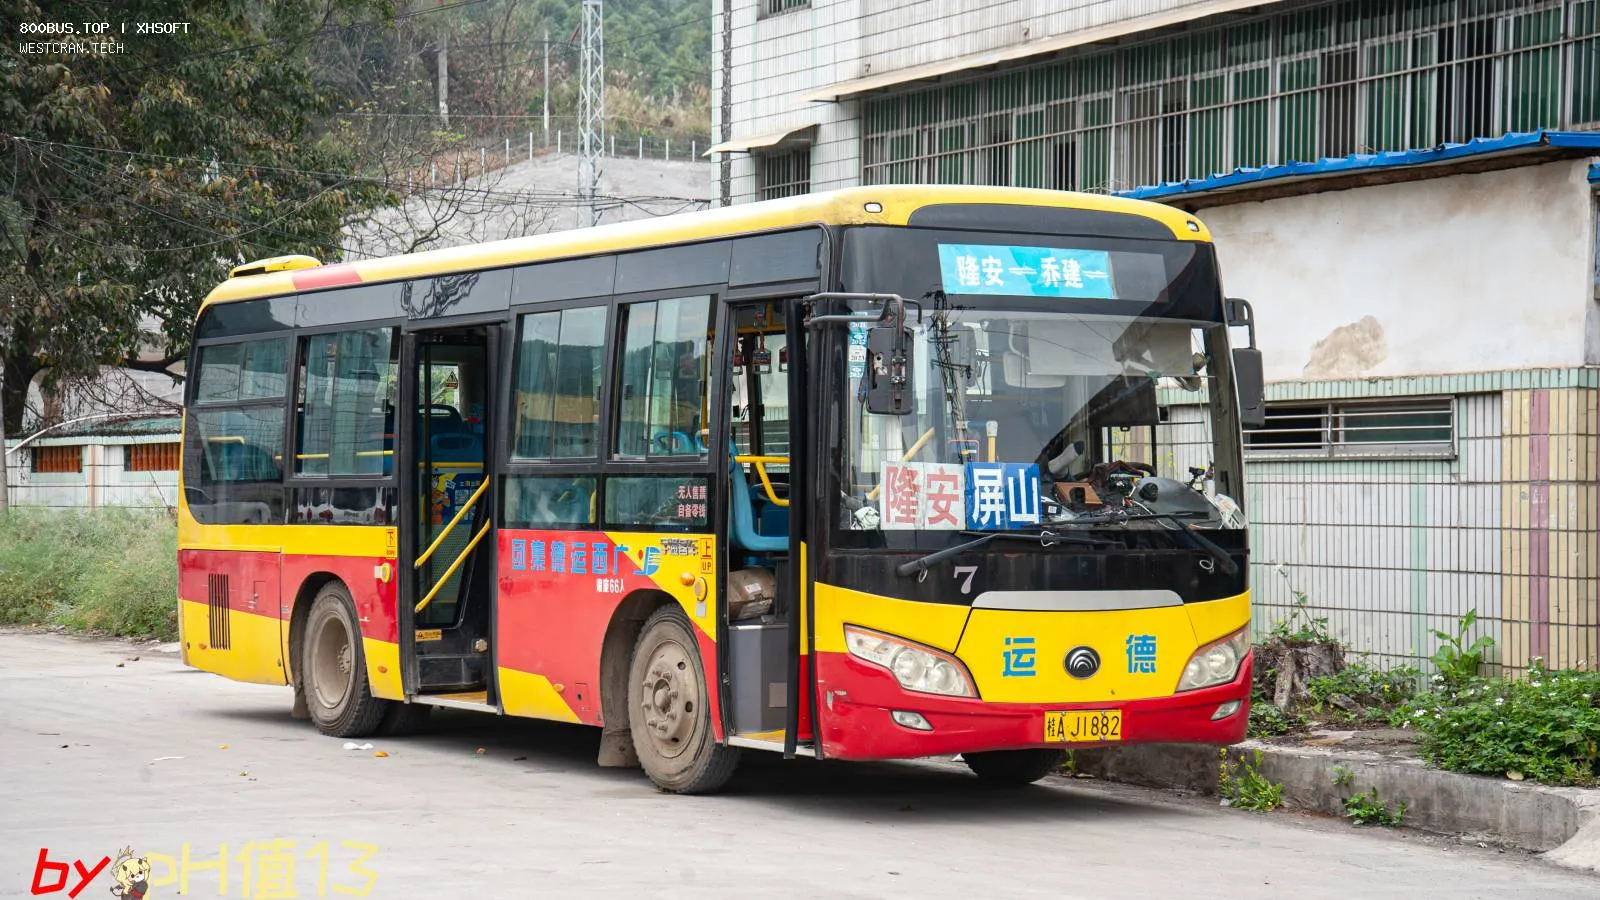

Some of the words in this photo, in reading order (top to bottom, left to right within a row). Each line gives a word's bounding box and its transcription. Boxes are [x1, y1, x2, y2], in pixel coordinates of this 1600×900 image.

[957, 254, 1005, 288] 隆安
[1040, 256, 1084, 289] 乔建
[678, 485, 707, 500] 无人售票
[885, 464, 960, 528] 隆安
[972, 468, 1040, 526] 屏山
[677, 503, 706, 519] 自备零钱
[702, 539, 712, 557] 上
[702, 562, 711, 571] UP
[953, 566, 977, 594] 7
